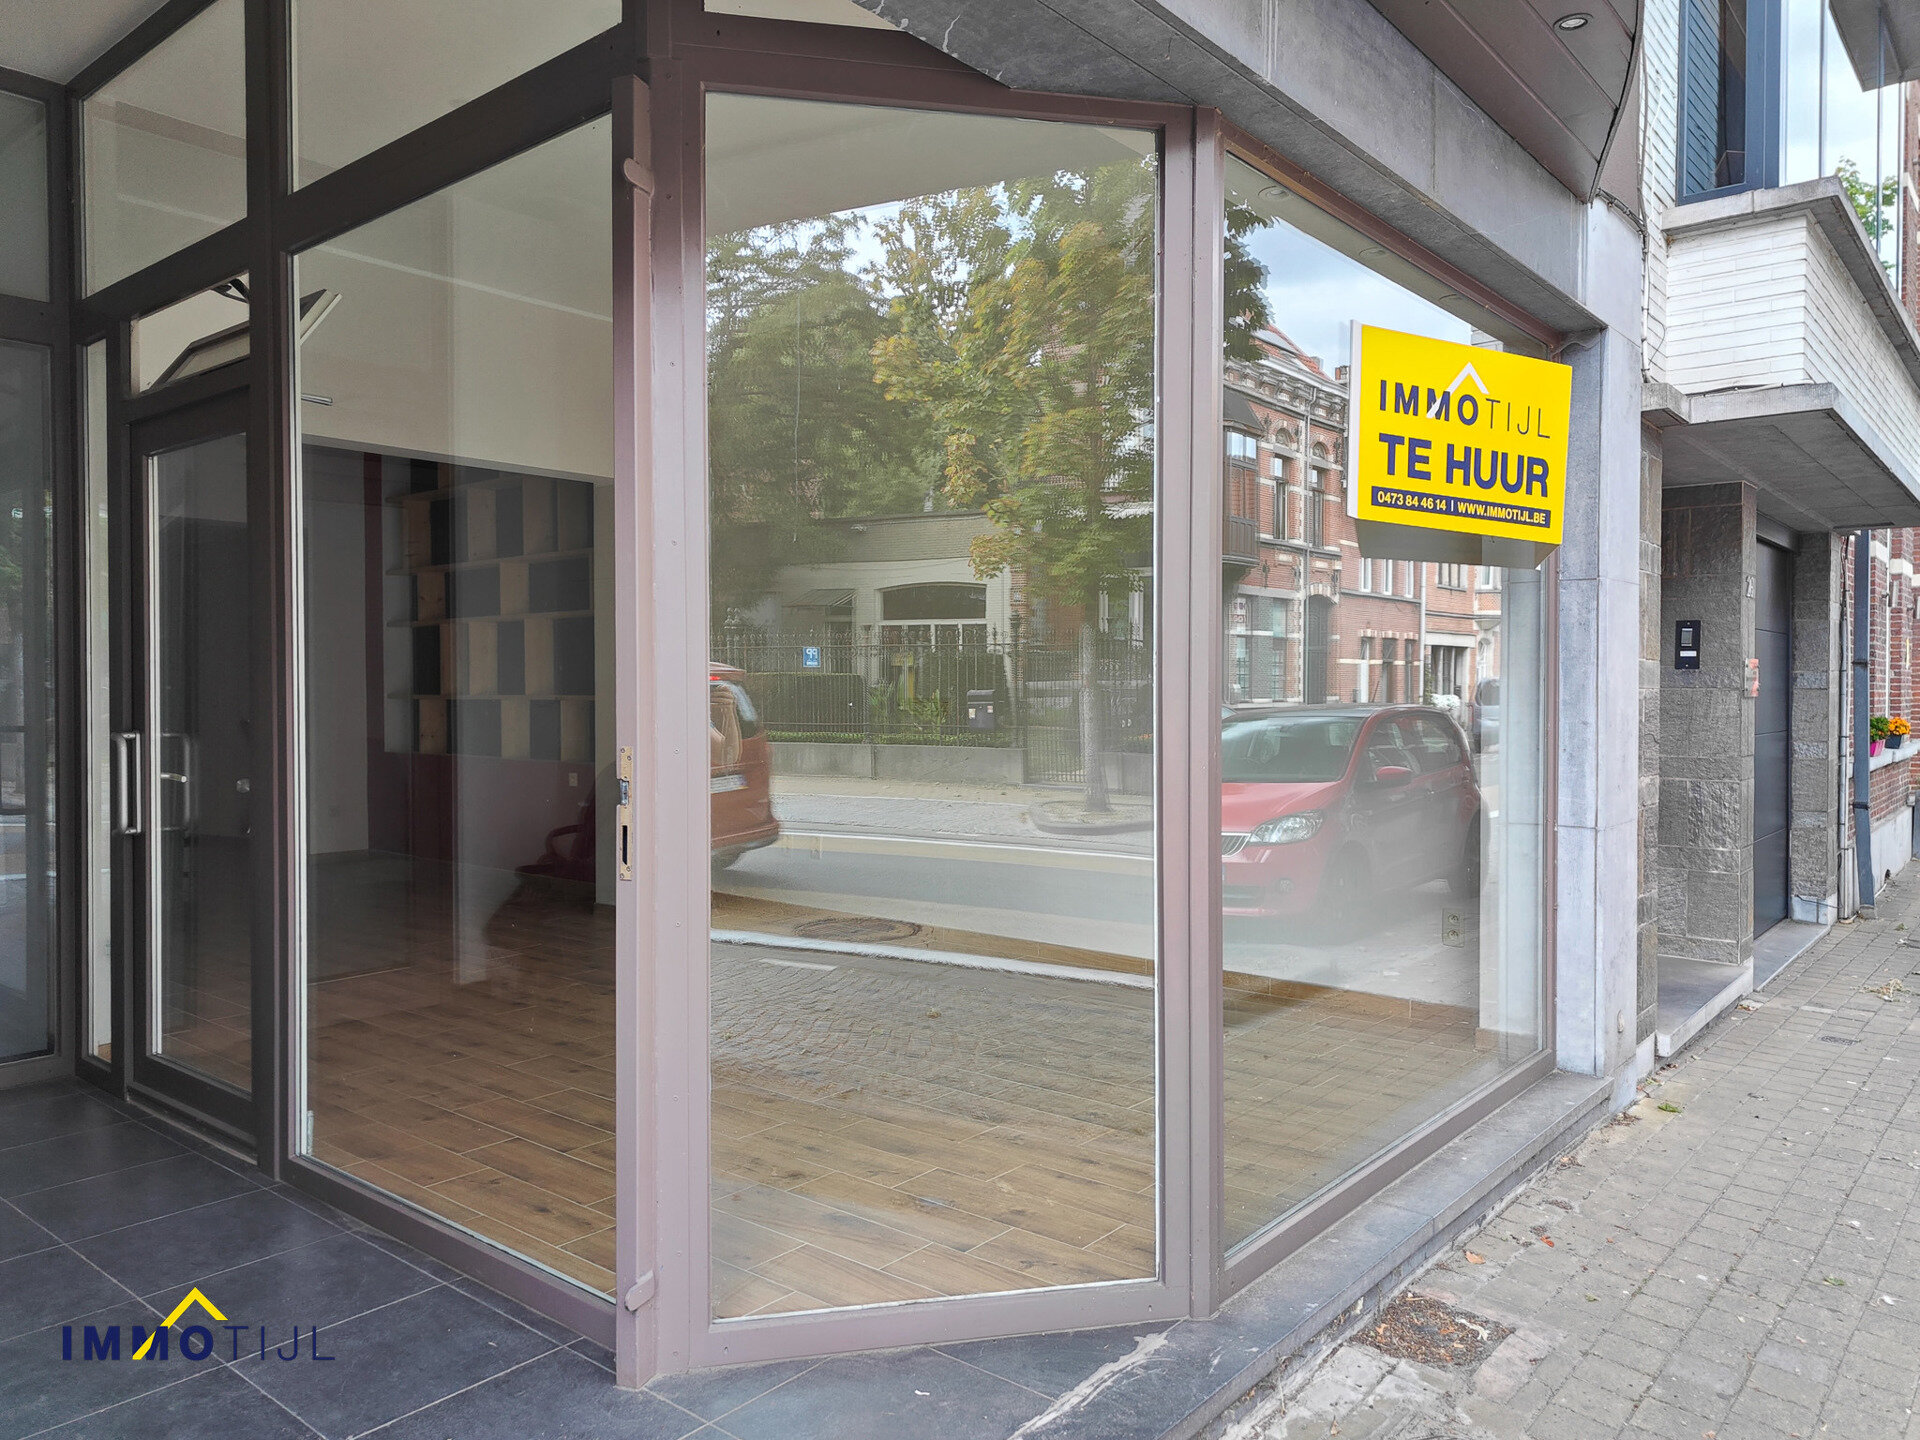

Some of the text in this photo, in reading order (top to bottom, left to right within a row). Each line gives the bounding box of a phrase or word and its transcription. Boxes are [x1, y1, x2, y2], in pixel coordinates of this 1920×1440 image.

[1379, 433, 1549, 497] TE HUUR
[1377, 491, 1403, 505] 0473
[1405, 494, 1418, 507] 84
[1457, 502, 1546, 524] WWW.IMMOTIJL.BE
